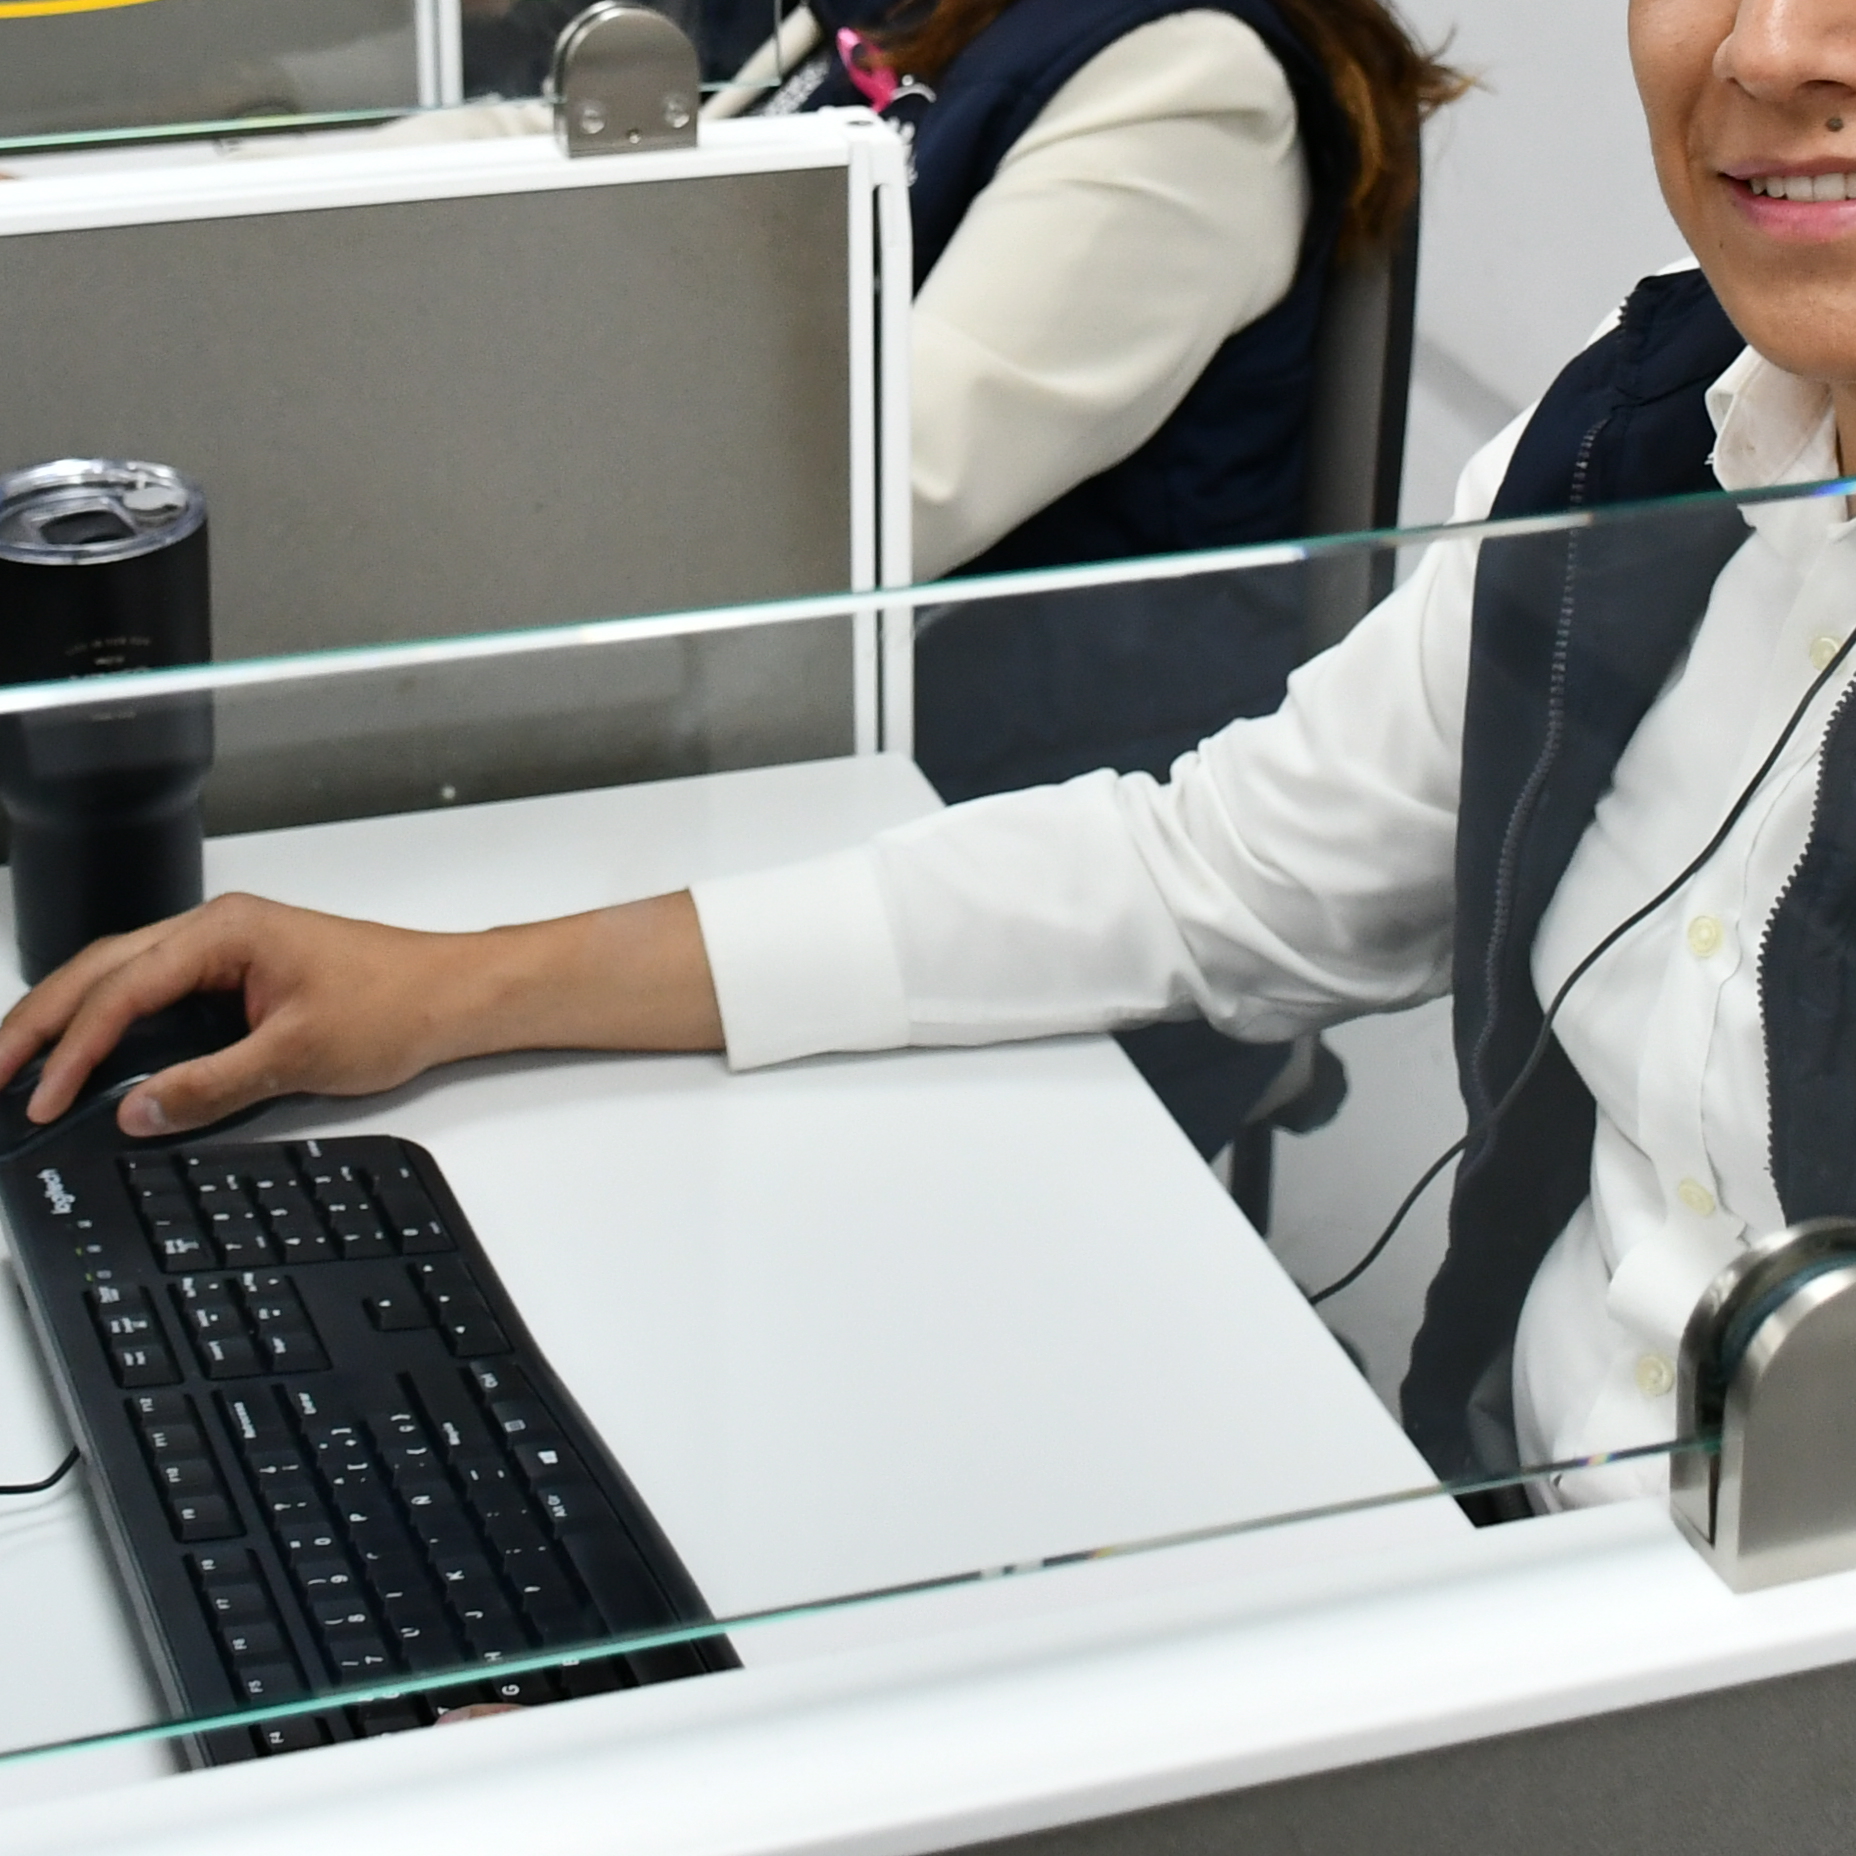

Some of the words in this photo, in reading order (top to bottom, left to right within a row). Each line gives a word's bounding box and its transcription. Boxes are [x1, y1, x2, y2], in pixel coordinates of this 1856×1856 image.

[348, 1513, 368, 1523] P
[445, 1569, 465, 1582] K
[500, 1683, 521, 1697] G
